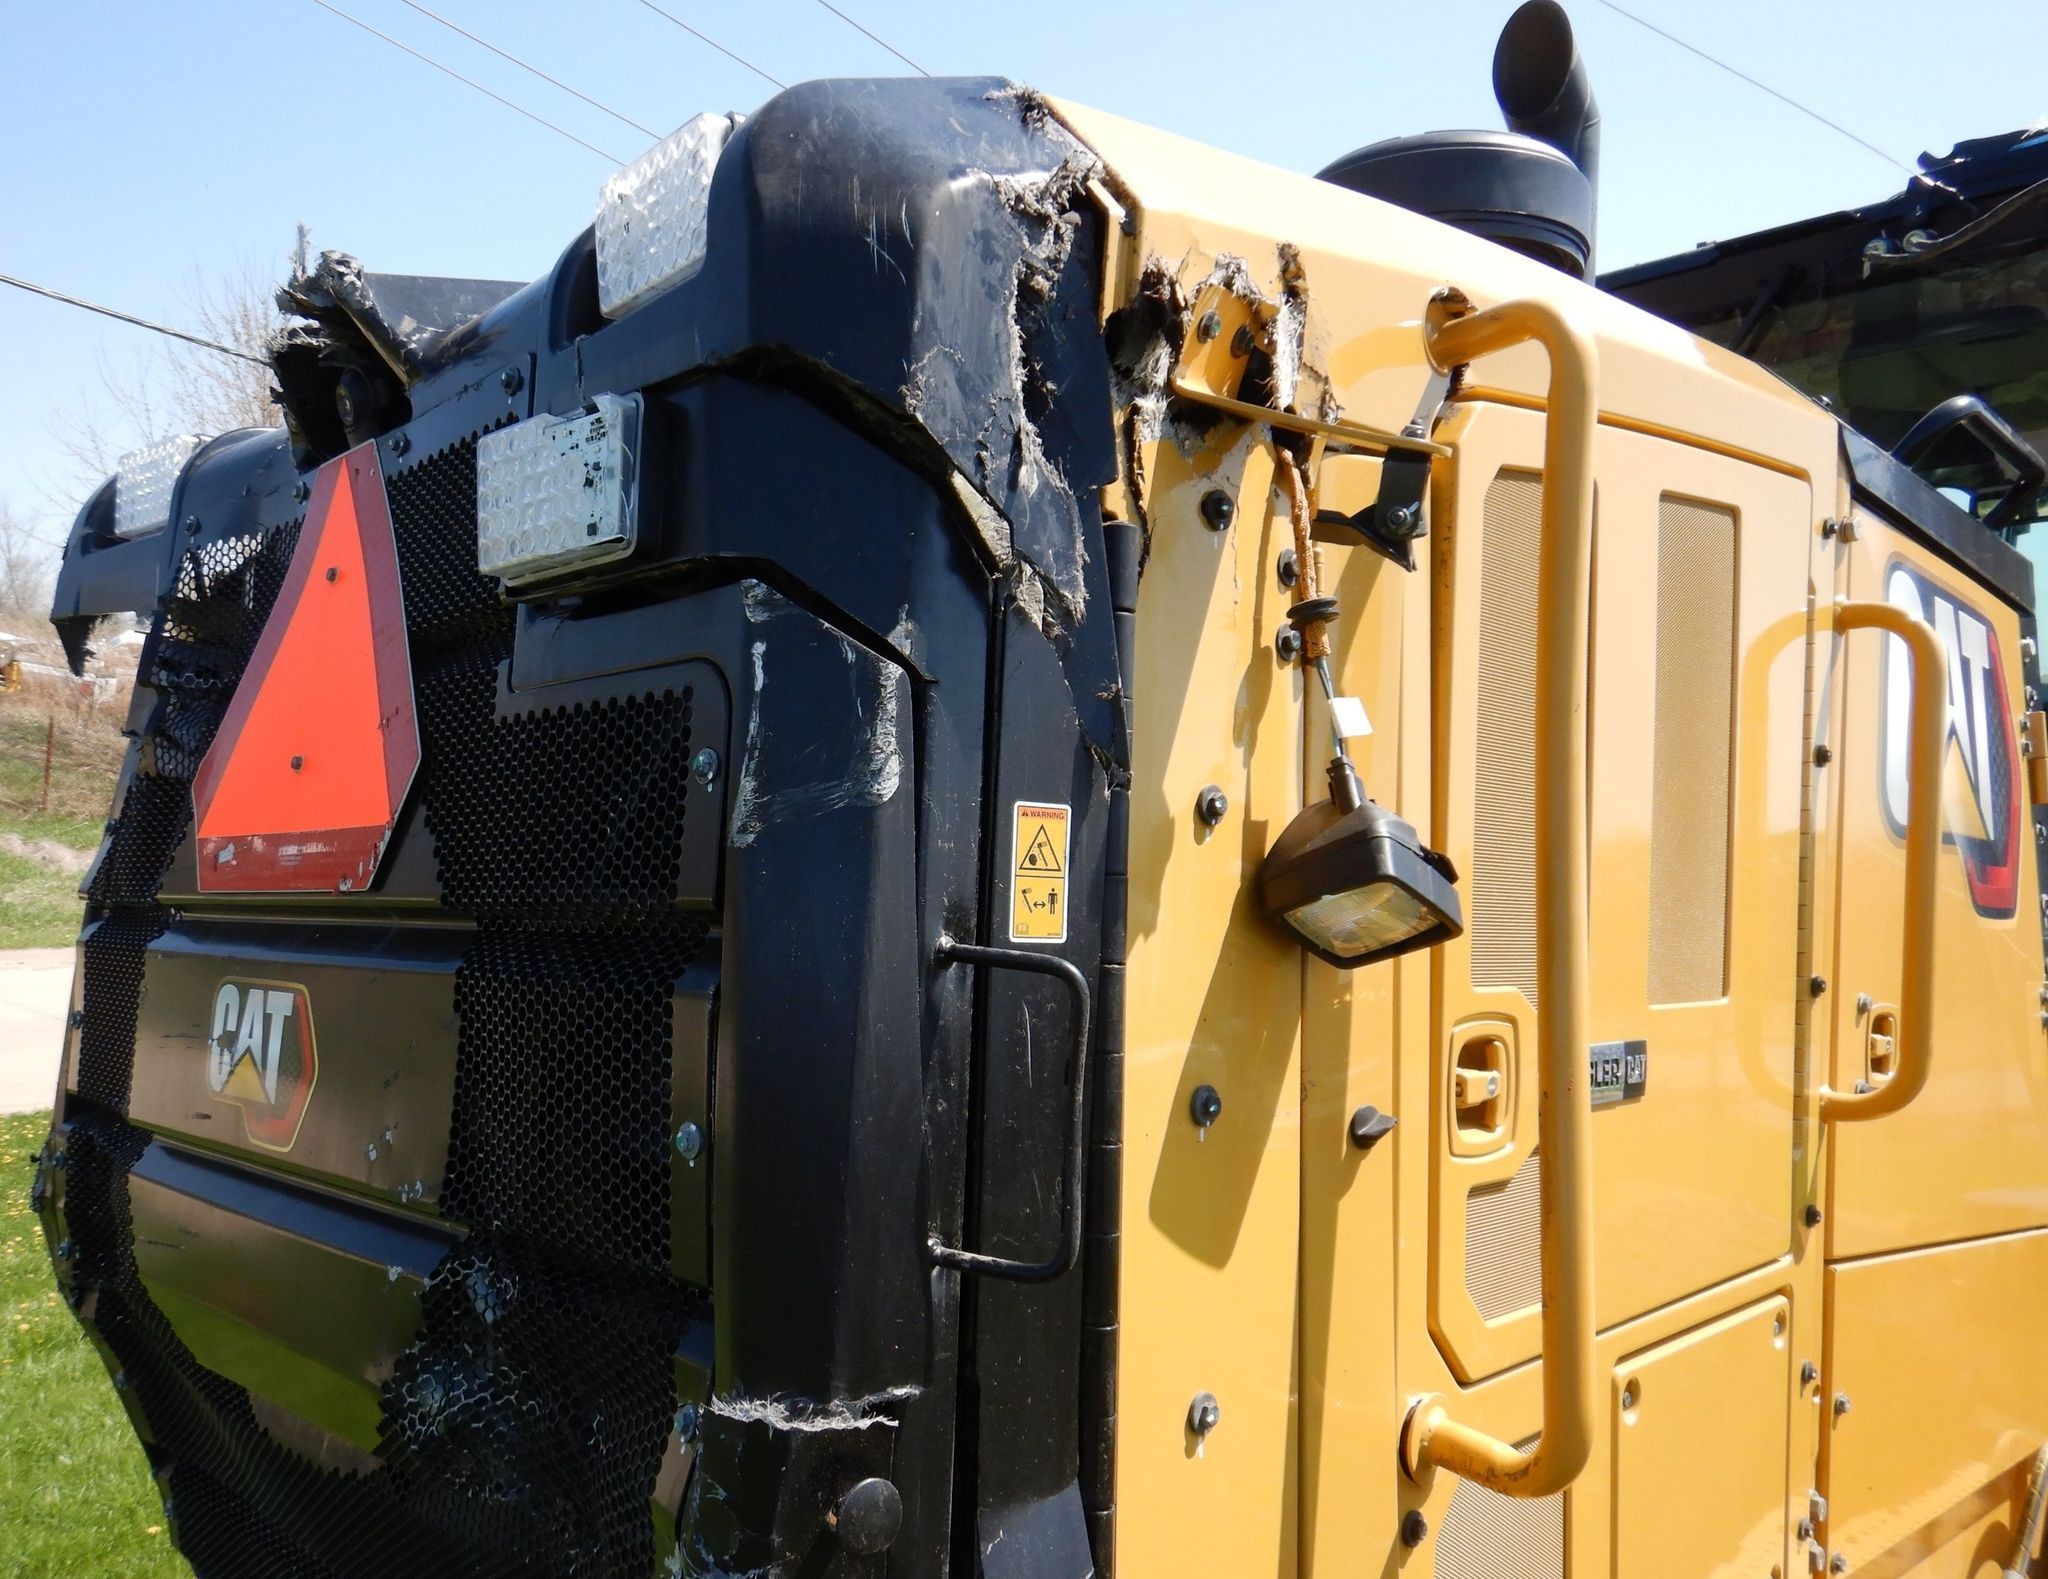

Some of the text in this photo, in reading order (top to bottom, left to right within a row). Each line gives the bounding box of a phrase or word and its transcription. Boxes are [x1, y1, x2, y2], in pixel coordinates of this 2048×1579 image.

[1030, 810, 1065, 820] WARNING
[209, 983, 295, 1105] CAT
[1626, 1053, 1647, 1085] CAT
